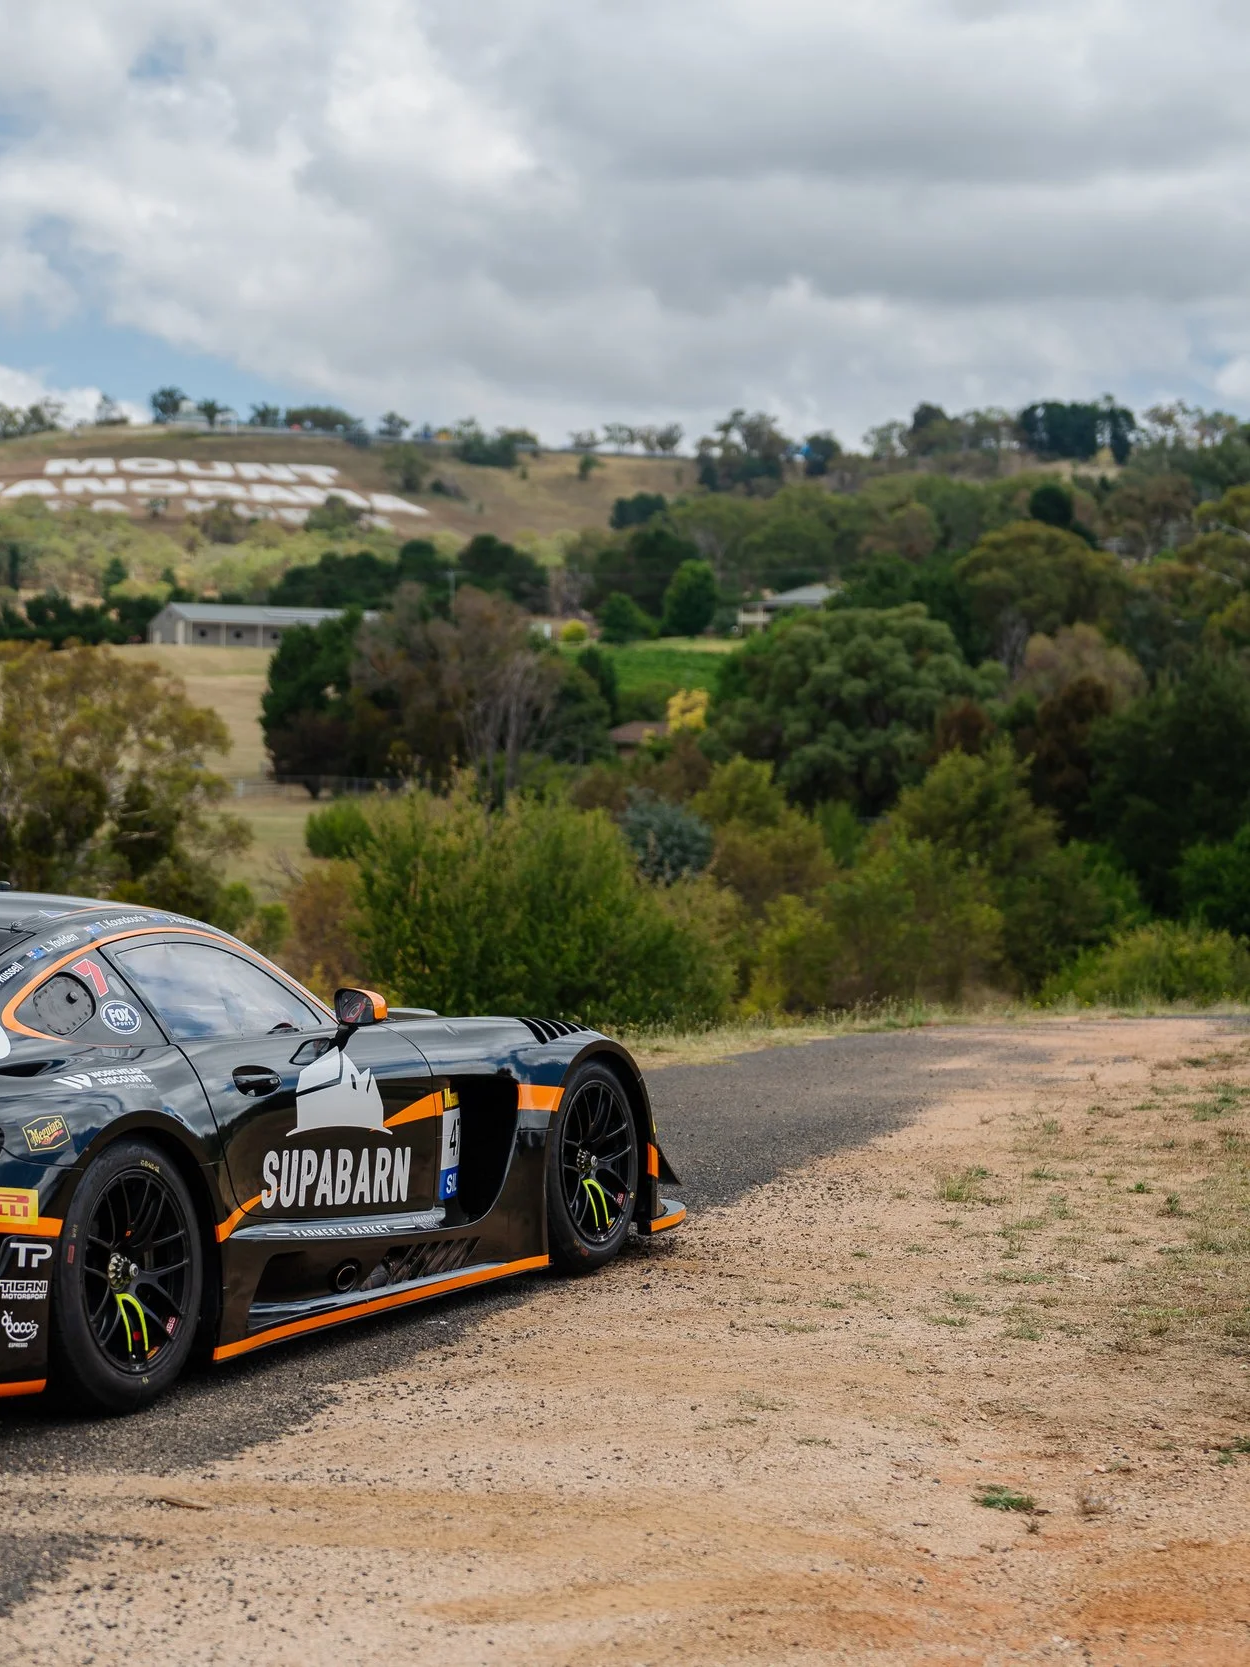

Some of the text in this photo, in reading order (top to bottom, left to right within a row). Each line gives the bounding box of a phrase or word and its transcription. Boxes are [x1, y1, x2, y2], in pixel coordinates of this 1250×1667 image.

[44, 457, 340, 485] MOUNT
[46, 933, 80, 948] Youlden
[107, 1008, 133, 1023] FOX
[87, 1067, 145, 1078] WORKWEAR
[96, 1074, 152, 1085] DISCOUNTS
[261, 1146, 412, 1209] SUPABARN
[292, 1224, 391, 1238] FARMER'S MARKET
[10, 1242, 53, 1268] TP
